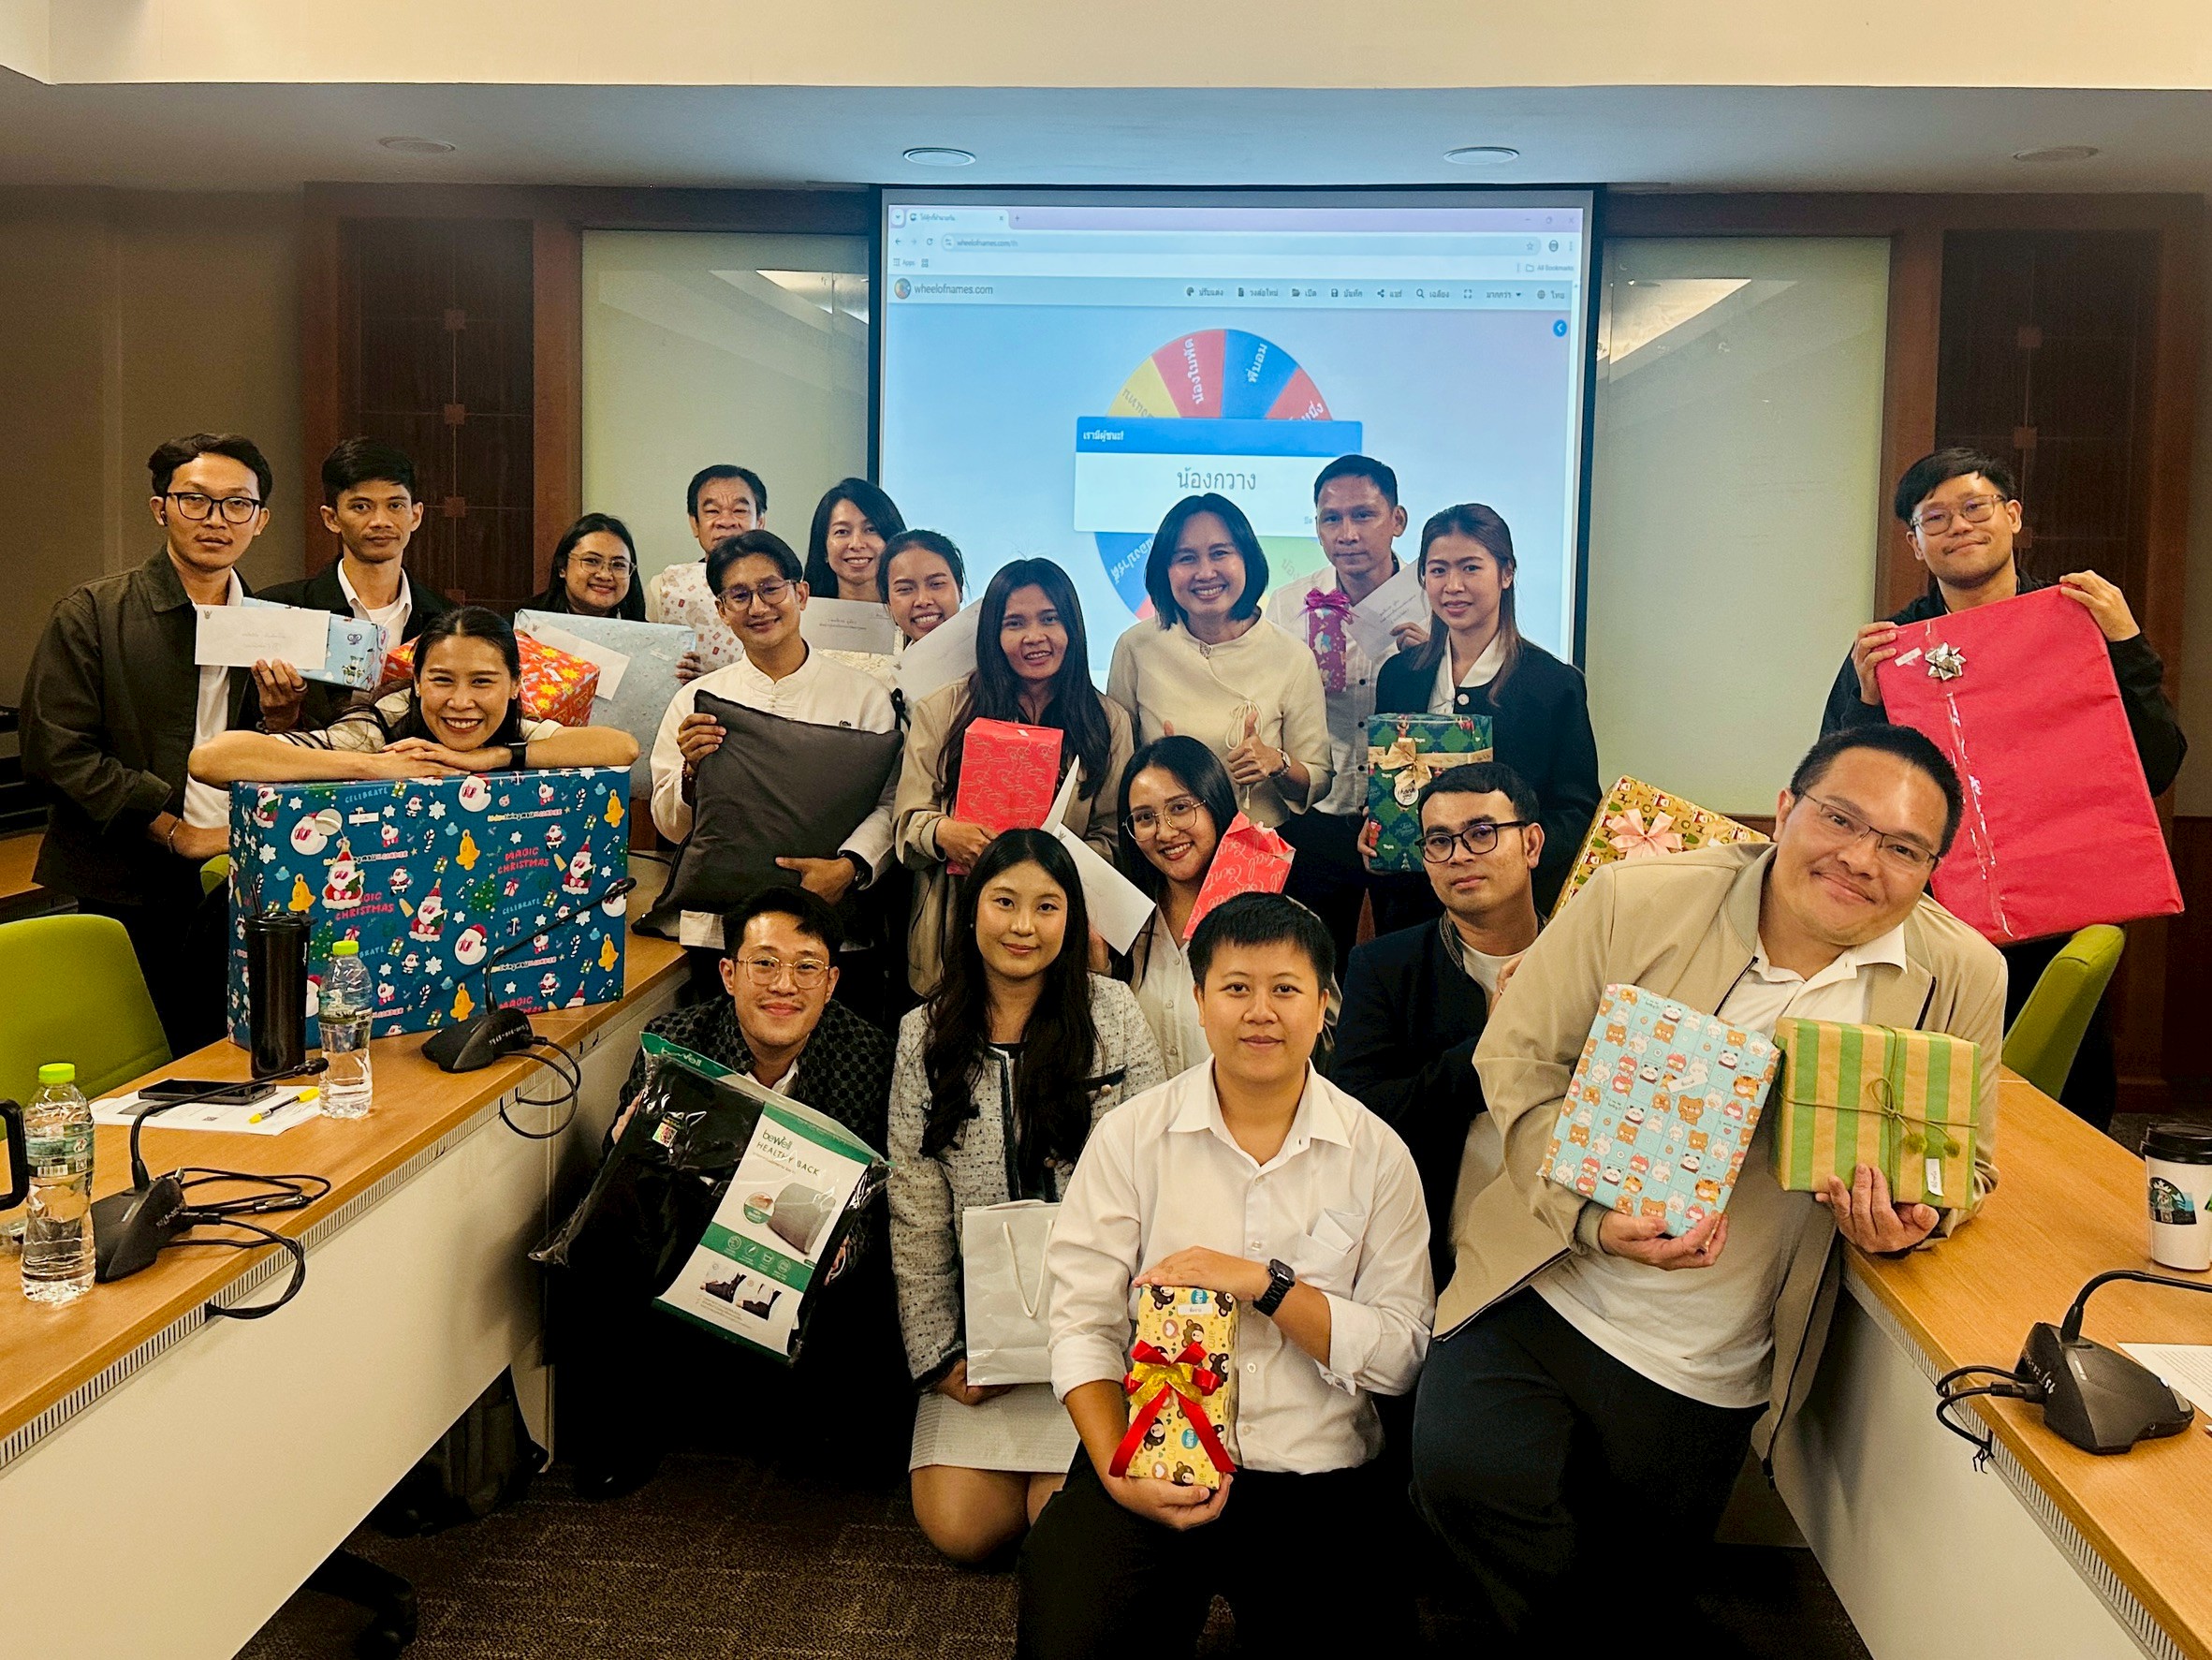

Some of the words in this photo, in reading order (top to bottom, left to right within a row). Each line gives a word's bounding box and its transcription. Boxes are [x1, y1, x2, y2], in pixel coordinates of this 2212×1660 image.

[914, 283, 993, 295] wheelofnames.com
[1177, 466, 1257, 491] น้องกวาง
[505, 846, 539, 861] MAGIC
[497, 858, 549, 874] CHRISTMAS
[335, 903, 395, 920] CHRISTMAS
[498, 995, 534, 1009] MAGIC
[796, 1159, 821, 1176] BACK
